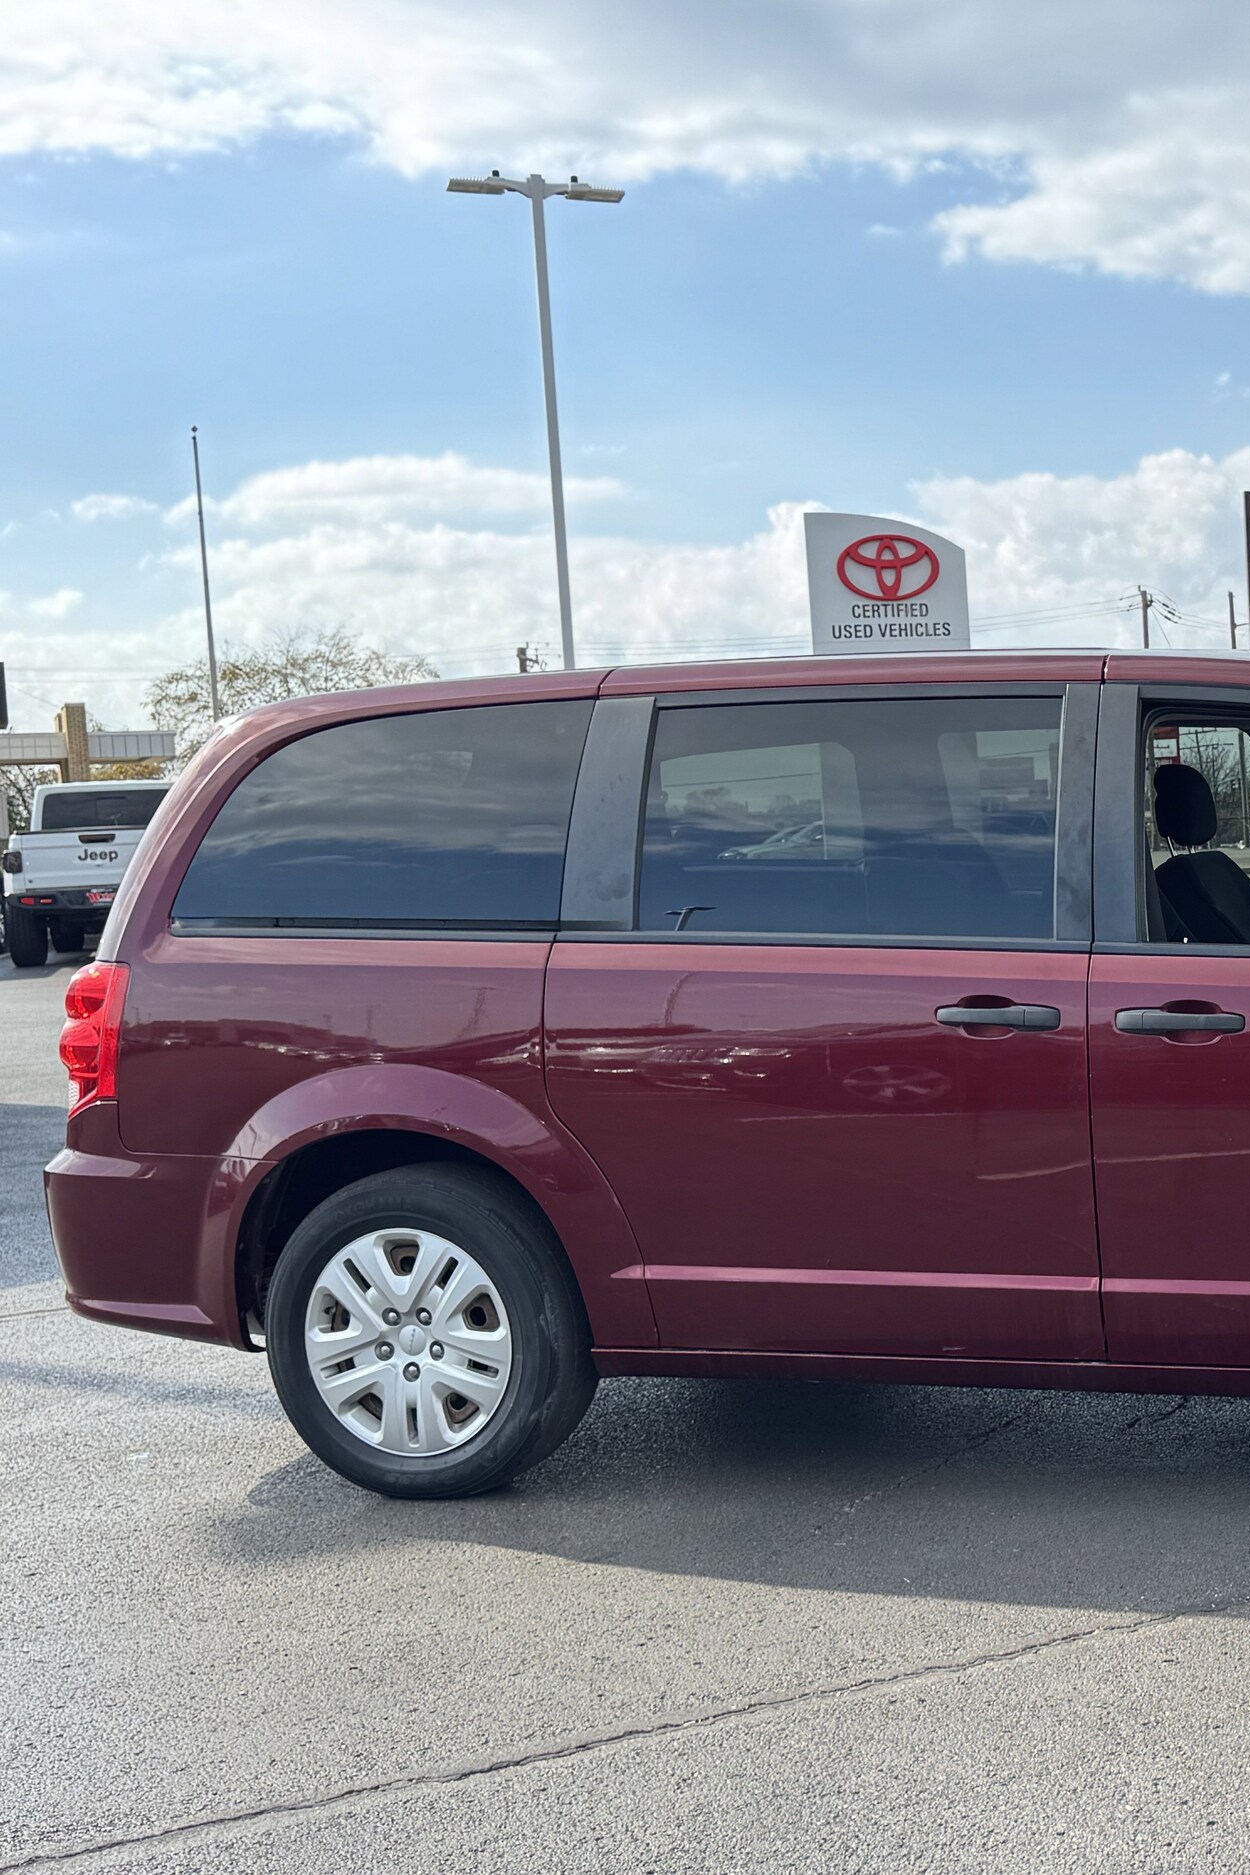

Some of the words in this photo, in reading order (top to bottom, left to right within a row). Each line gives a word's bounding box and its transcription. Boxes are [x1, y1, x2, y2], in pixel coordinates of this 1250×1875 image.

[852, 603, 929, 619] CERTIFIED
[832, 623, 873, 639] USED
[878, 621, 952, 638] VEHICLES
[77, 848, 119, 863] Jeep
